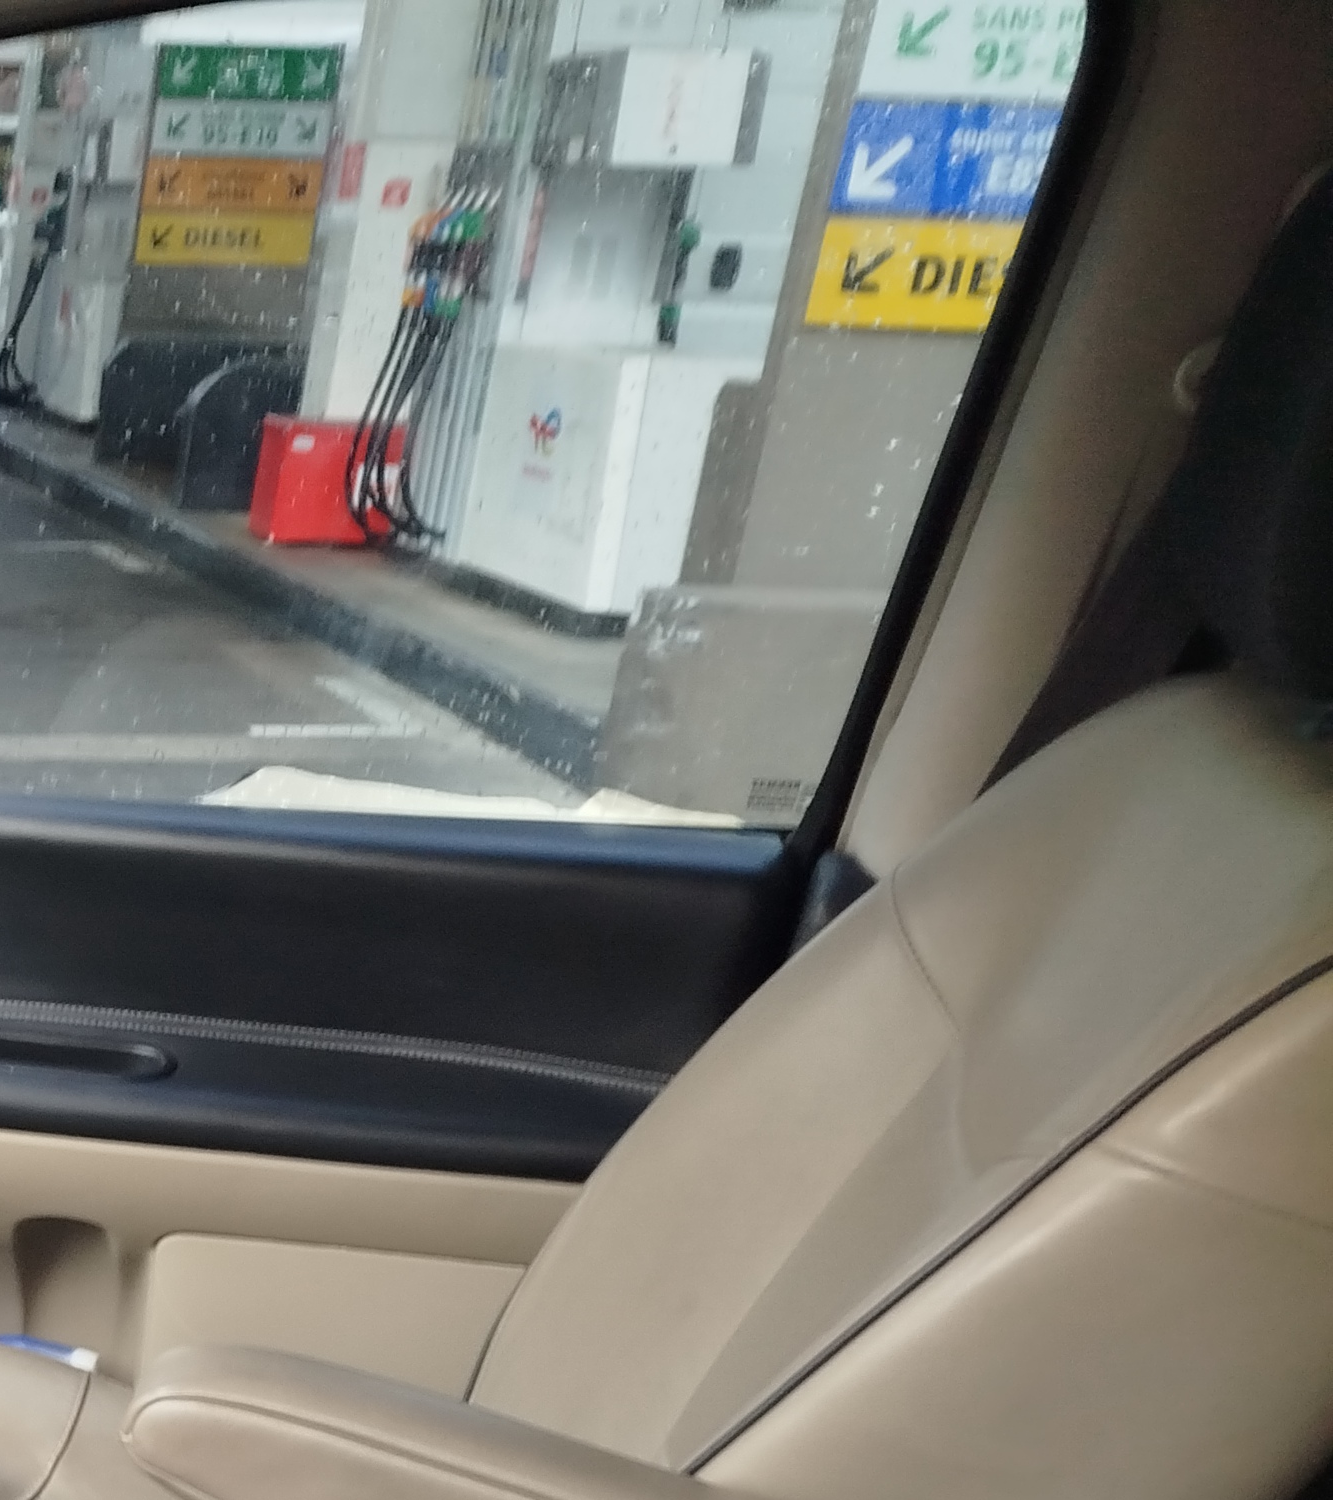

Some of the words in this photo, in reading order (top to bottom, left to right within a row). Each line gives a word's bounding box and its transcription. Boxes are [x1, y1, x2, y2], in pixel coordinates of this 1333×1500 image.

[972, 5, 1046, 32] SANS
[971, 38, 1079, 81] 95-E
[183, 226, 263, 249] DIESEL
[909, 253, 1014, 298] DIE
